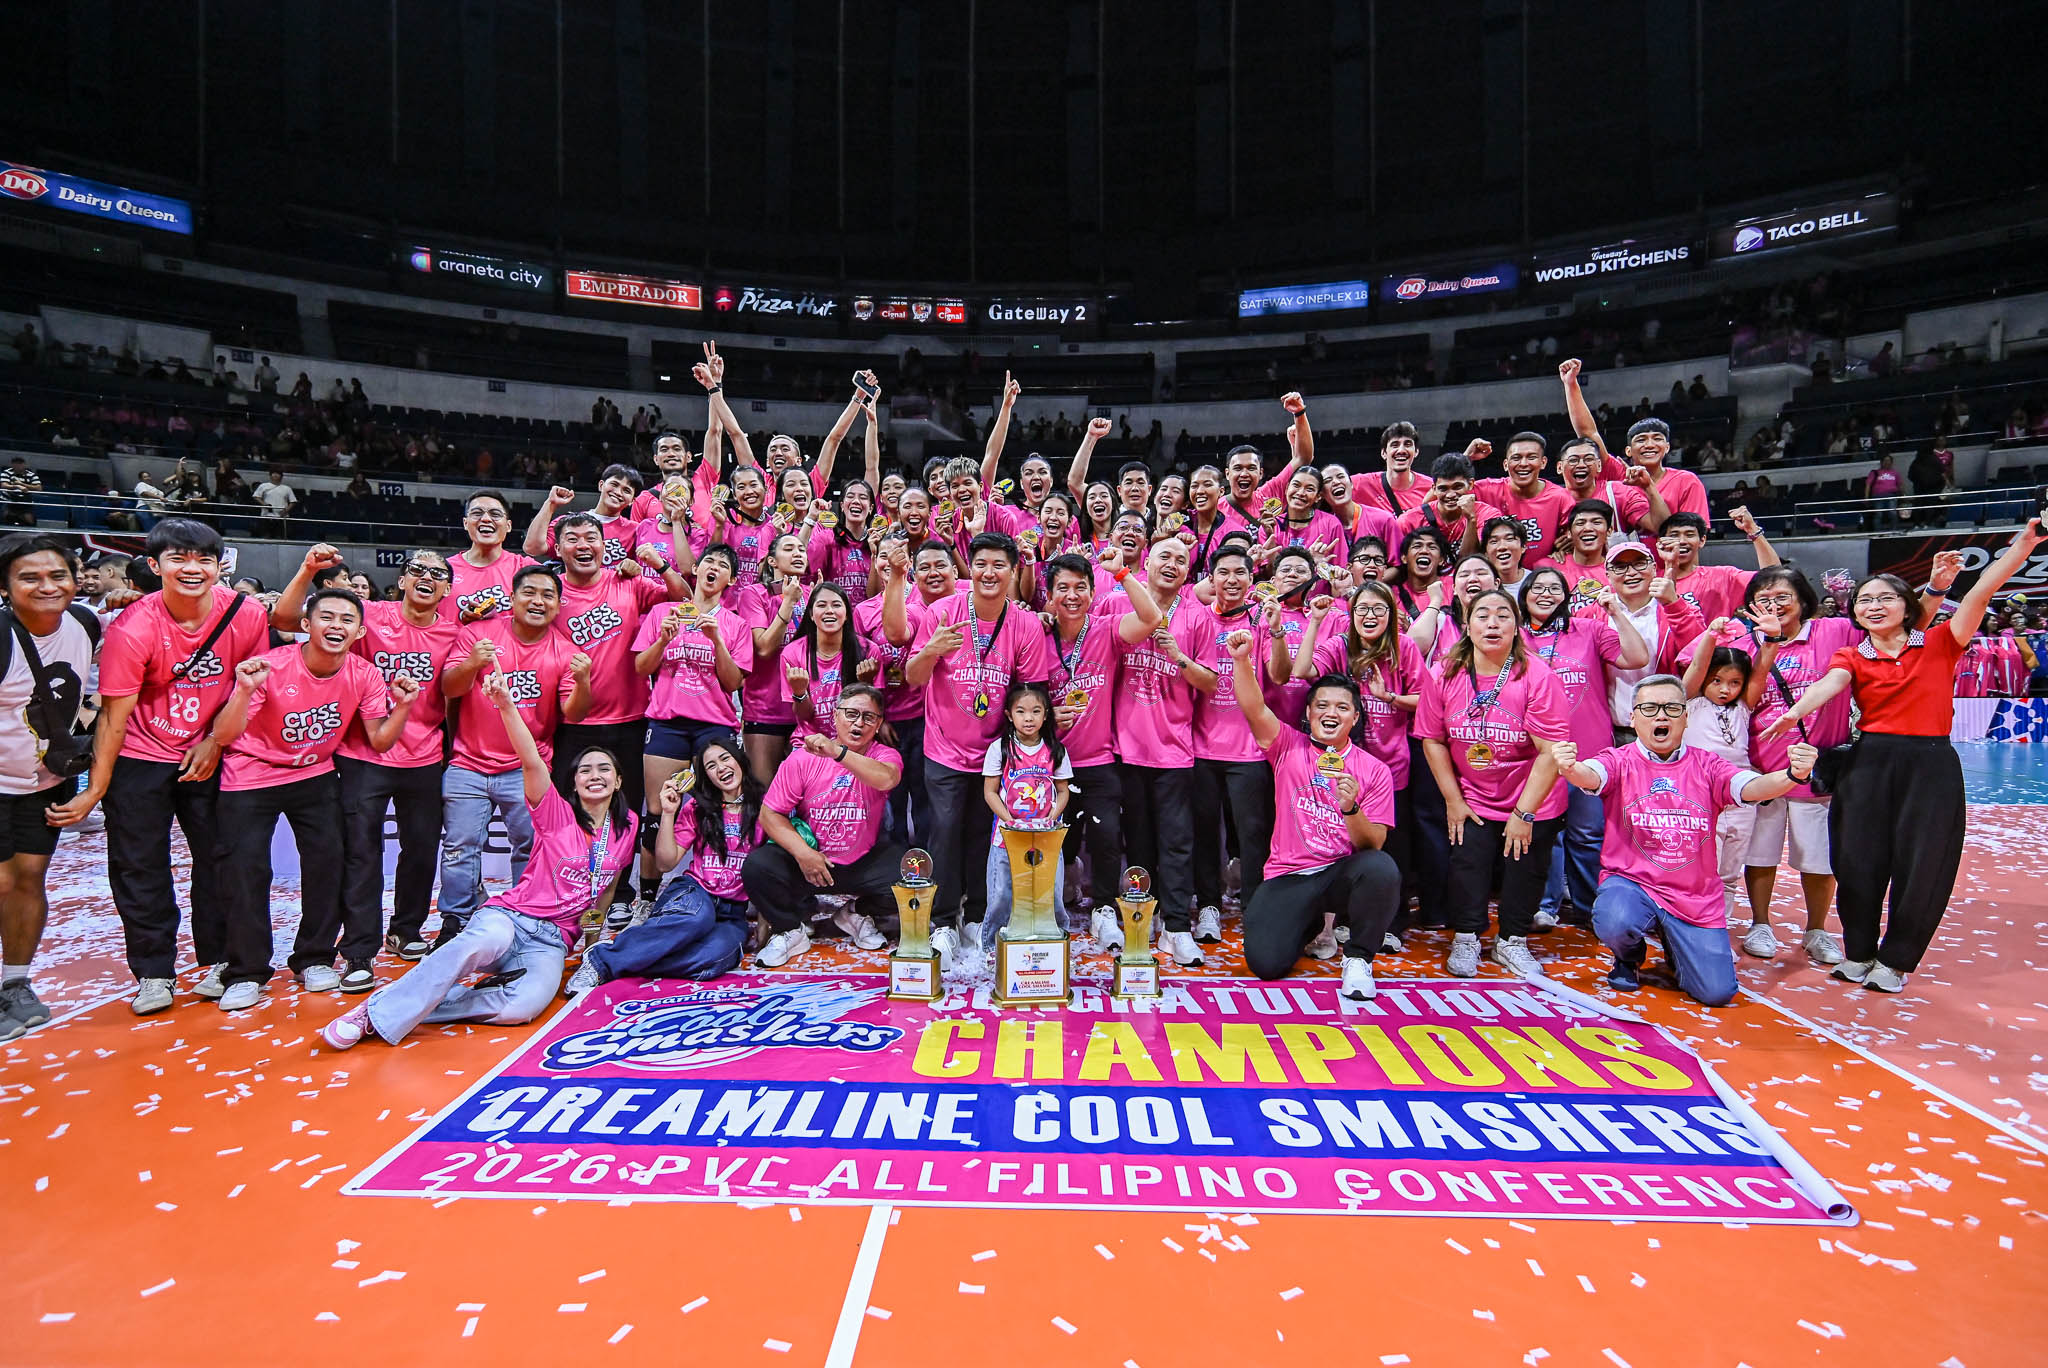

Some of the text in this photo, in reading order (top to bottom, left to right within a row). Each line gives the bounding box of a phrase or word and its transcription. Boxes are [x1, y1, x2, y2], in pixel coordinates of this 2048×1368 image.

[4, 174, 40, 195] DQ
[58, 186, 112, 211] Dairy
[1767, 210, 1866, 241] TACO BELL
[439, 258, 543, 288] araneta city
[1535, 246, 1689, 283] WORLD KITCHENS
[579, 278, 689, 304] EMPERADOR
[1401, 283, 1423, 295] DQ
[1428, 281, 1458, 292] Dairy
[737, 291, 794, 313] Pizza
[1240, 290, 1368, 310] GATEWAY CINEPLEX 18
[881, 310, 907, 320] Cignal
[938, 311, 962, 321] Cignal
[1075, 305, 1086, 321] 2
[380, 485, 403, 496] 112
[378, 552, 405, 565] 112
[567, 602, 614, 633] criss
[571, 611, 623, 646] cross
[374, 651, 431, 669] criss
[666, 647, 716, 663] CHAMPIO
[170, 693, 200, 723] 28
[284, 702, 340, 728] criss
[150, 716, 191, 738] Allianz
[1008, 765, 1048, 780] Creamline
[1013, 782, 1046, 810] 24
[1297, 796, 1345, 826] CHAMPIO
[1631, 813, 1709, 831] CHAMPIONS
[617, 991, 743, 1015] Creamline
[928, 986, 1602, 1018] CGATULATION
[632, 995, 793, 1037] Cool
[561, 1012, 896, 1065] Smashers
[911, 1019, 1694, 1090] CHAMPIONS
[467, 1086, 1776, 1157] CREAMLINE COOL SMASHERS
[420, 1151, 616, 1184] 2026
[819, 1159, 948, 1192] ALL
[987, 1161, 1299, 1200] FILIPINO
[1333, 1168, 1806, 1209] CONFERENC
